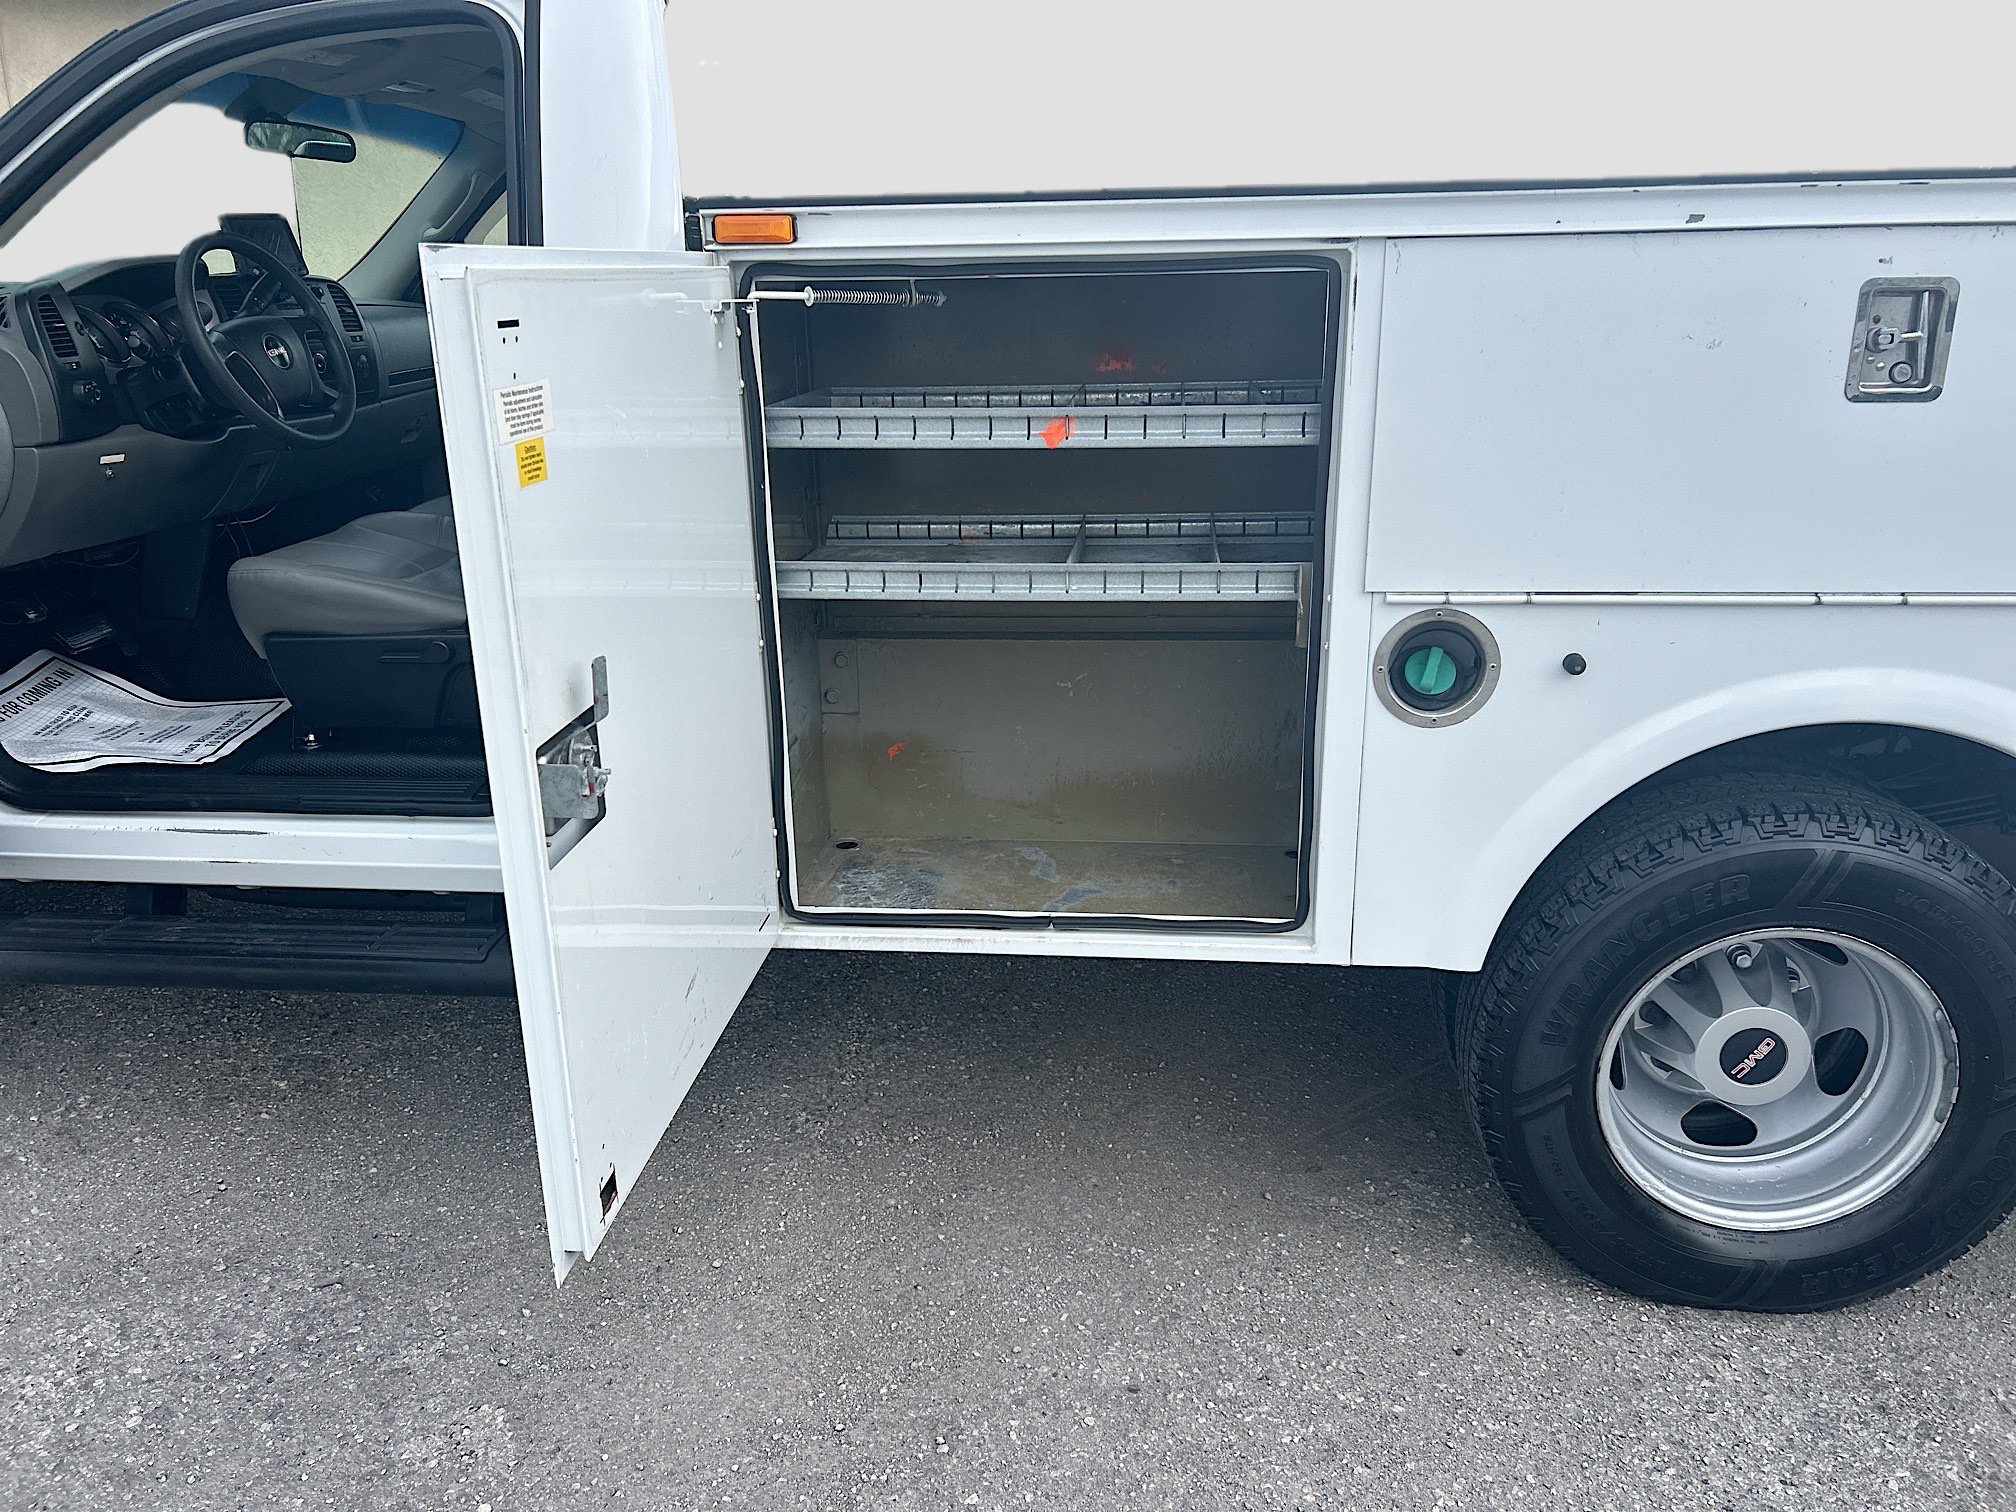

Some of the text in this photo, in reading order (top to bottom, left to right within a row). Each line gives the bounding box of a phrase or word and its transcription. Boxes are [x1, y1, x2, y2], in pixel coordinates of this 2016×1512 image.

[0, 701, 27, 719] FOR
[16, 676, 63, 706] COMING
[52, 667, 75, 681] IN
[1538, 873, 1752, 1047] WRANGLER
[1893, 878, 2014, 976] WORKHORSE
[1730, 1037, 1776, 1079] GMC
